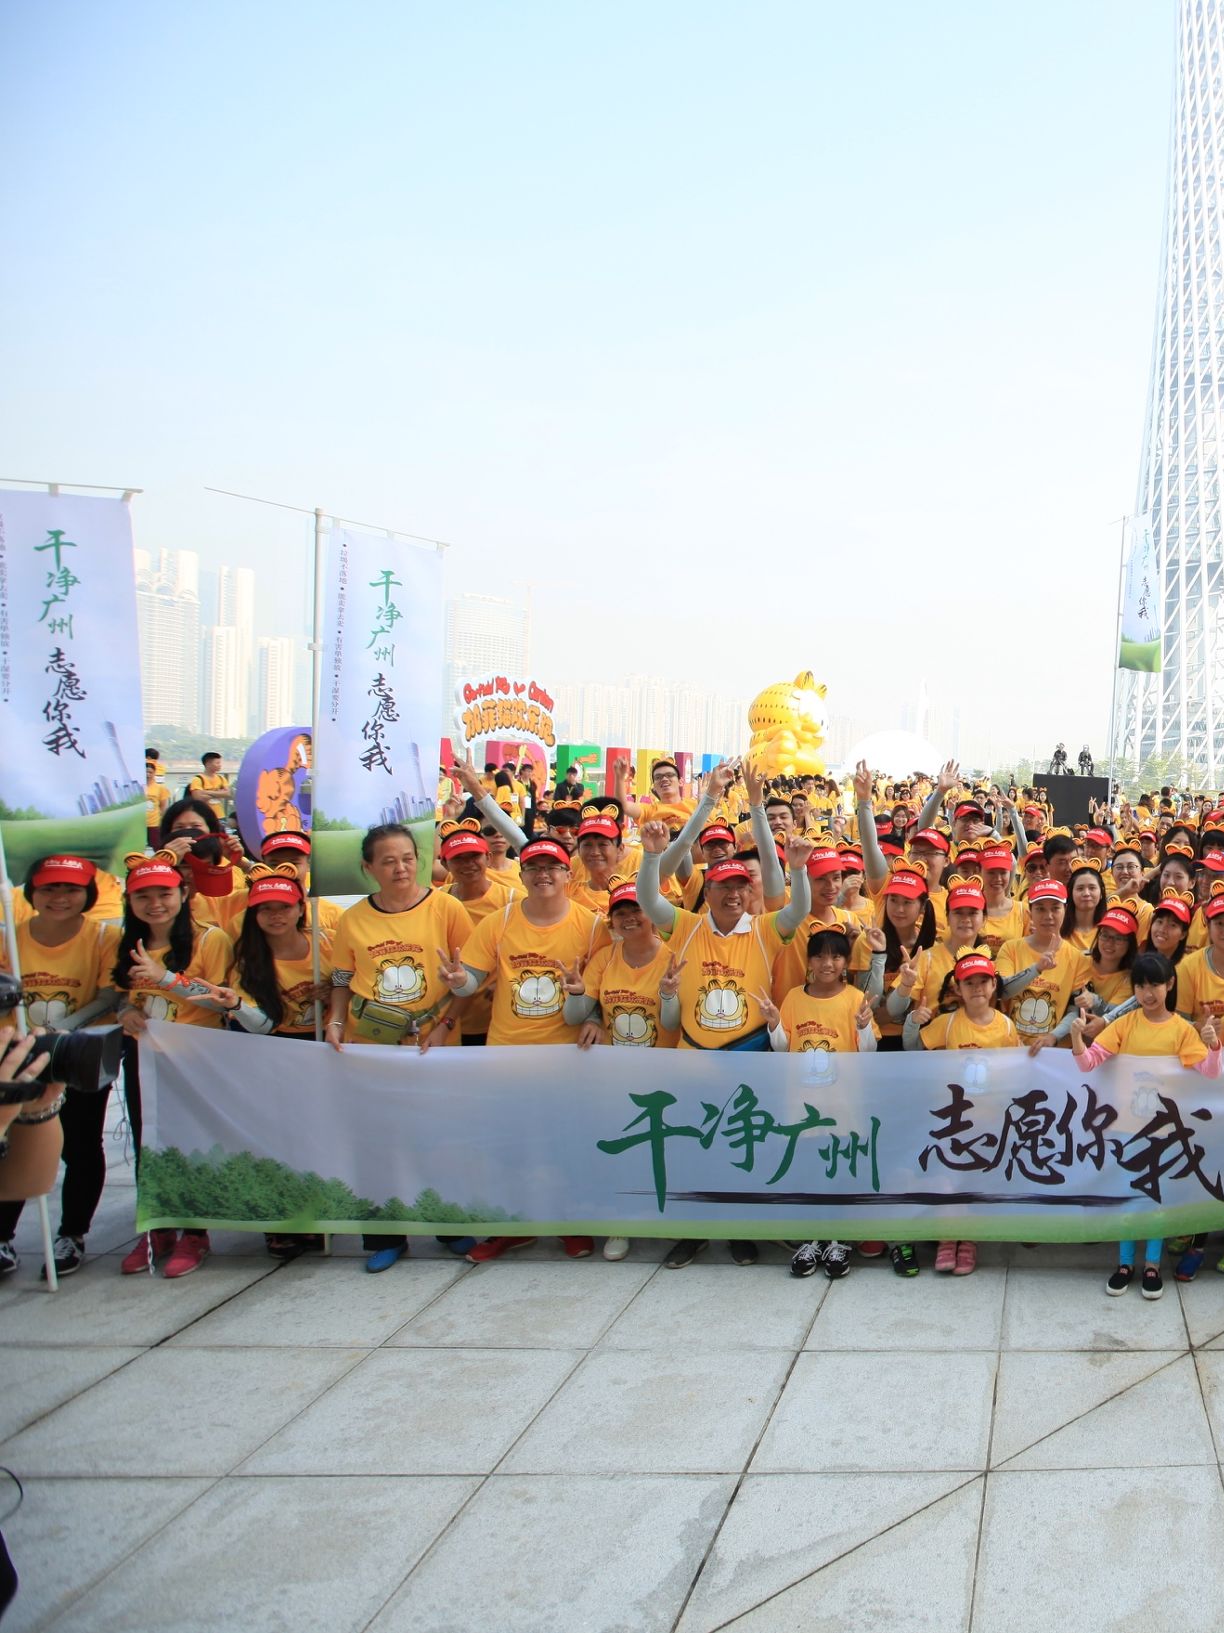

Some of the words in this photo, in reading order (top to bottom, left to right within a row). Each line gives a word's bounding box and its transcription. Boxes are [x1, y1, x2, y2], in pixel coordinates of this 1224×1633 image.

[33, 529, 81, 640] 干净广州
[366, 570, 404, 667] 干净广州
[42, 646, 87, 759] 志愿你我
[359, 673, 400, 775] 志愿你我
[598, 1082, 881, 1213] 干净广州
